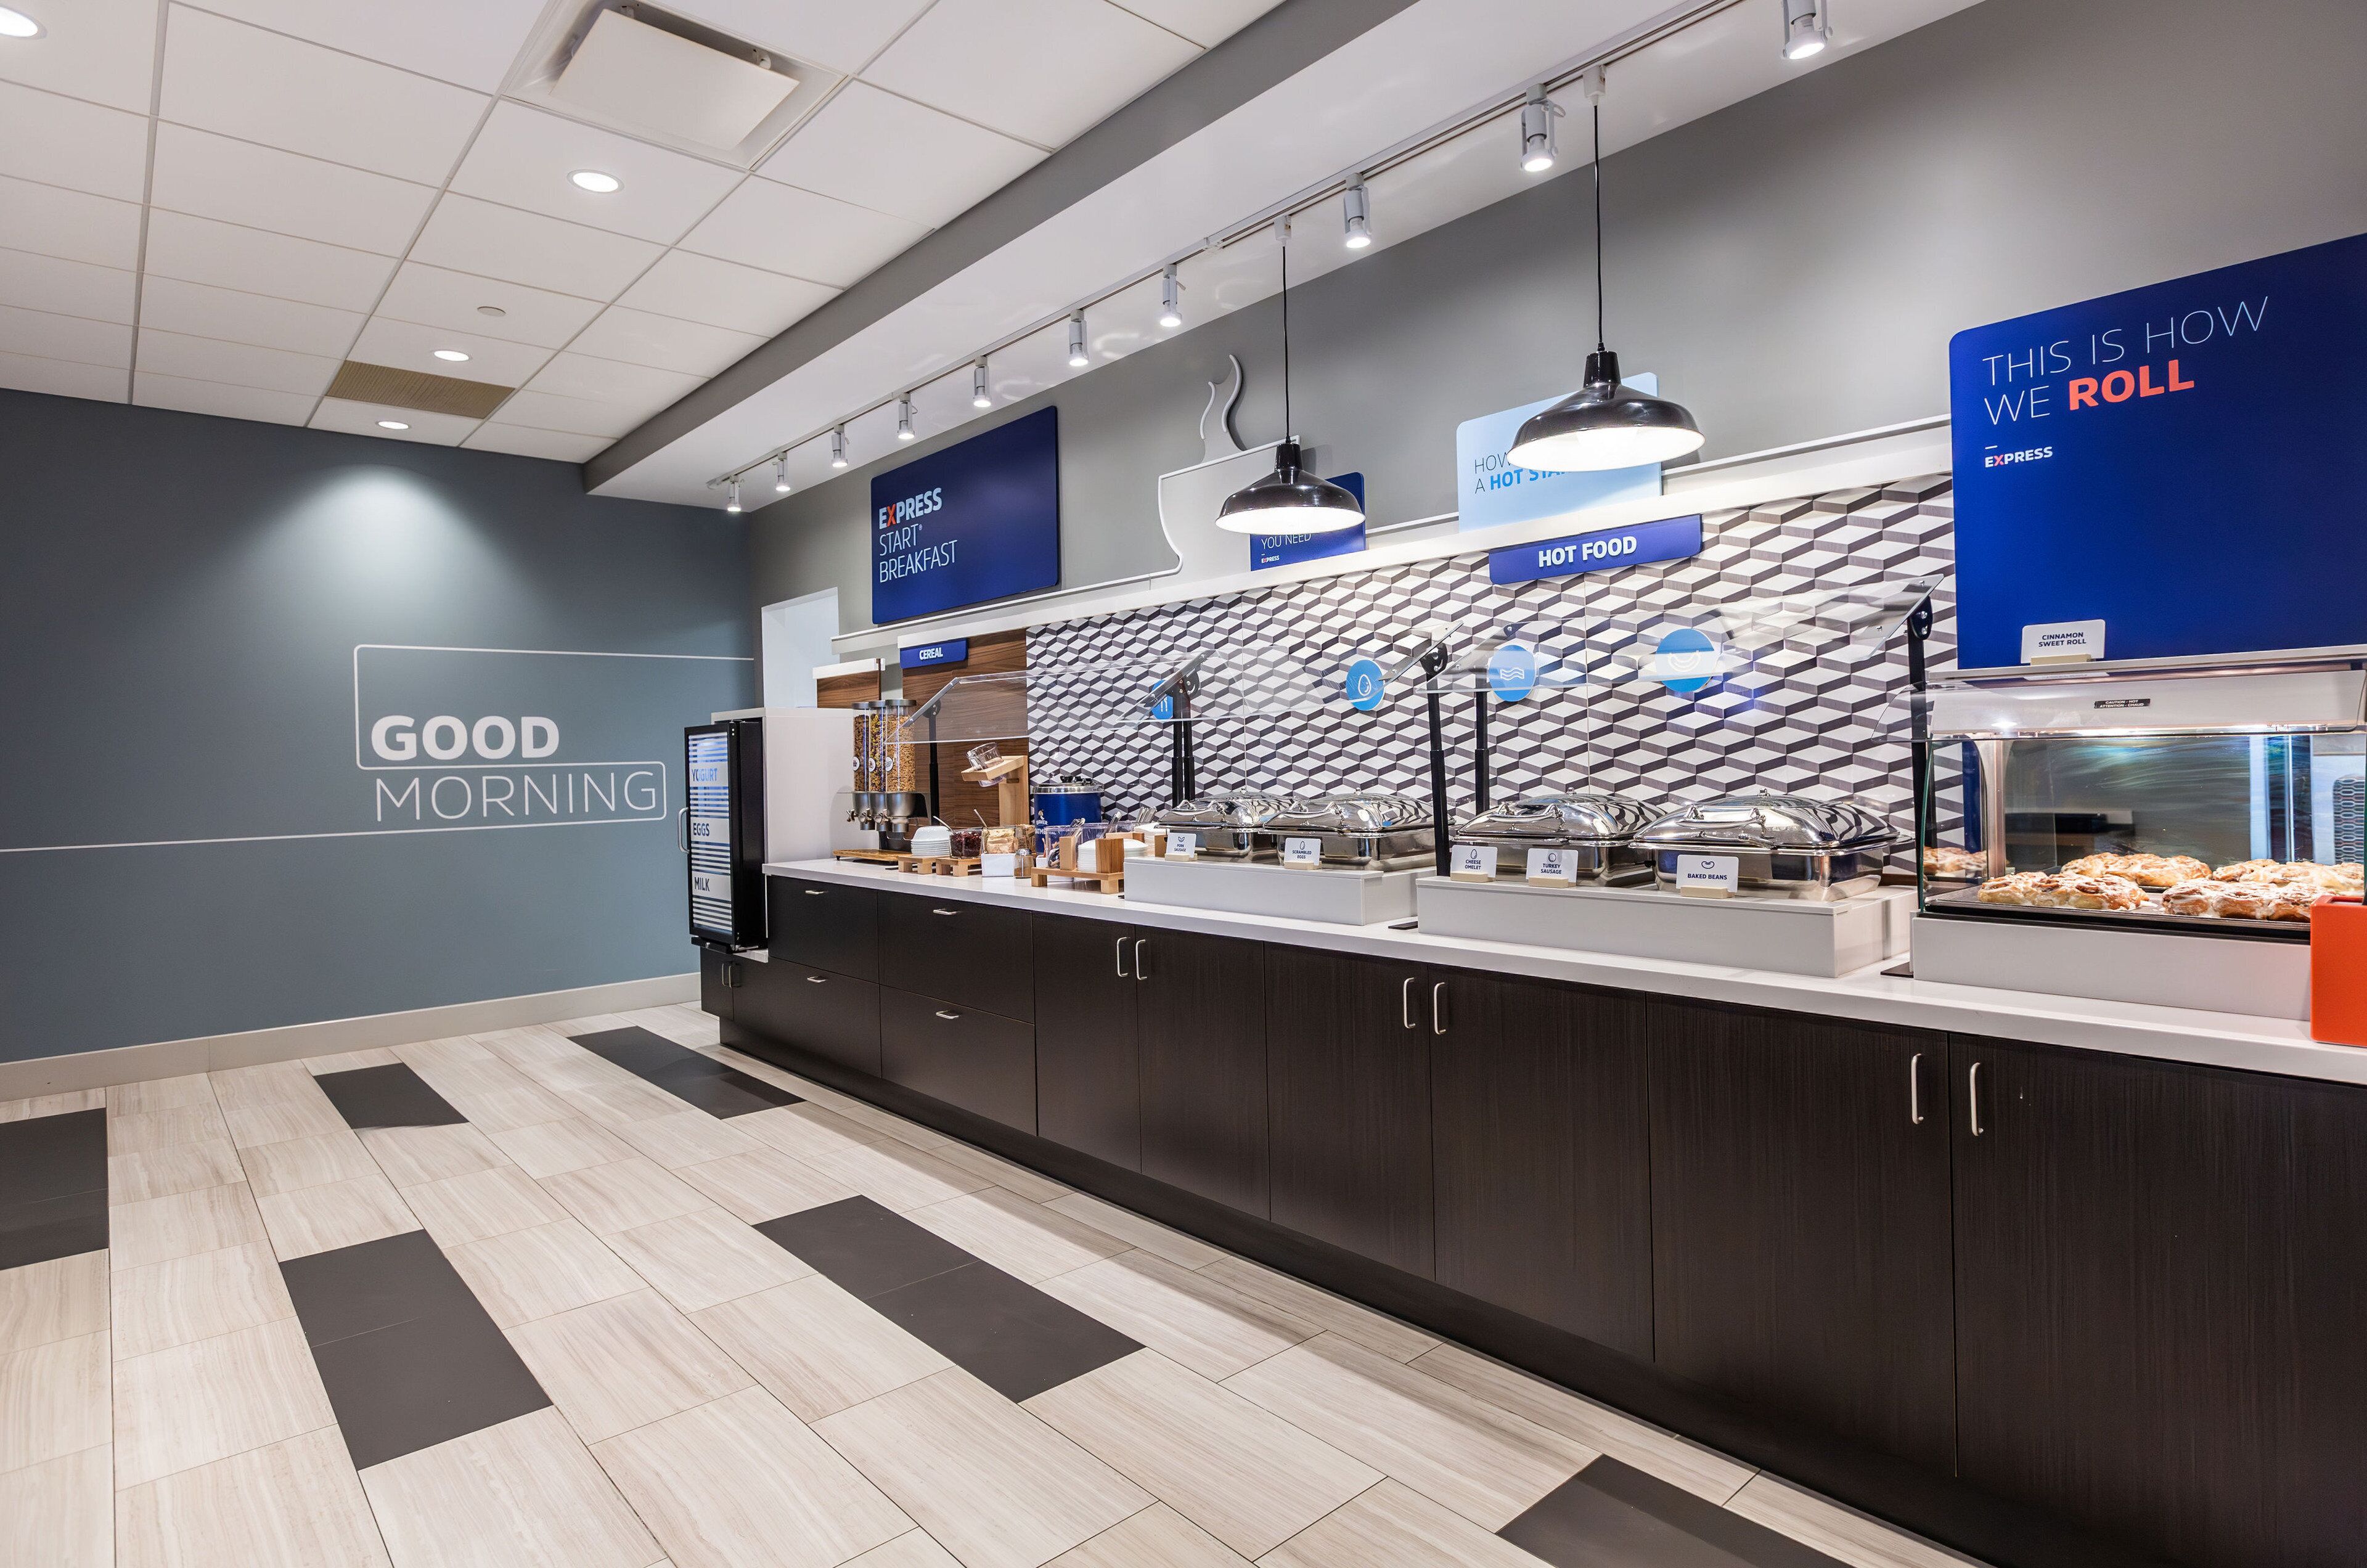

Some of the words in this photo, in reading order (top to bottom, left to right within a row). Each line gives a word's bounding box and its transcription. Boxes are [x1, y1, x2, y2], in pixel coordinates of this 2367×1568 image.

[1982, 340, 2071, 386] THIS
[2092, 329, 2125, 365] IS
[2146, 296, 2268, 353] HOW
[1984, 385, 2050, 425] WE
[2069, 359, 2195, 411] ROLL
[1984, 446, 2053, 468] EXPRESS
[1474, 478, 1486, 494] A
[1490, 468, 1523, 491] HOT
[879, 487, 943, 530] EXPRESS
[1261, 534, 1282, 550] YOU
[1285, 533, 1312, 545] NEED
[1538, 545, 1577, 568] HOT
[1582, 536, 1637, 561] FOOD
[880, 539, 958, 583] BREAKFAST
[1261, 555, 1280, 563] EXPRESS
[2042, 632, 2084, 640] CINNAMON
[918, 647, 944, 660] CEREAL
[371, 714, 560, 761] GOOD
[691, 767, 718, 782] YOGURT
[375, 770, 656, 822] MORNING
[692, 823, 710, 837] EGGS
[694, 876, 710, 892] MILK
